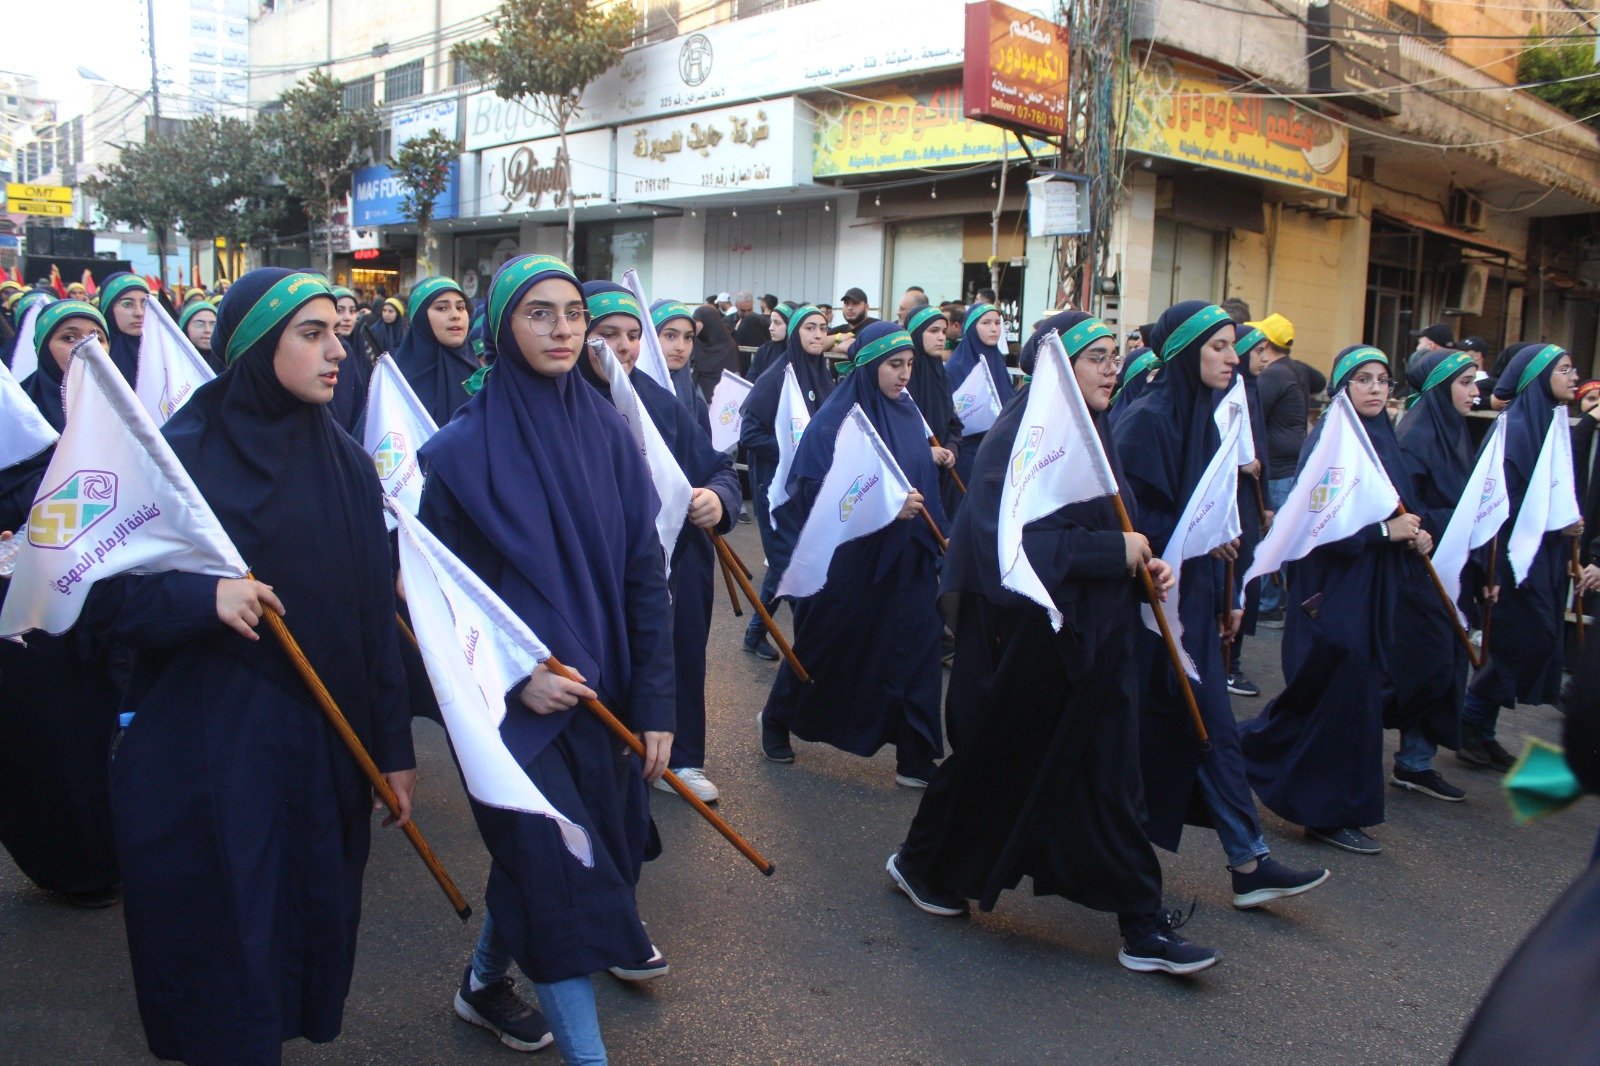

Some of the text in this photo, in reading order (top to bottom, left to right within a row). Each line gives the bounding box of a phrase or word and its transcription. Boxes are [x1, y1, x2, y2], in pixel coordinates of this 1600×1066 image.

[1010, 20, 1051, 45] مطعم
[996, 46, 1064, 84] الكومودور
[991, 71, 1064, 113] فول حمص مسبحة
[729, 109, 769, 148] شركة
[834, 83, 961, 150] الكومودور
[991, 96, 1016, 116] Delivery
[1049, 114, 1064, 130] 170
[1166, 87, 1314, 153] مطعم الكومودور
[633, 128, 683, 163] للصيرفة
[922, 145, 957, 162] مشوشة
[961, 142, 992, 158] مسبحة
[25, 186, 54, 198] OMT
[357, 179, 380, 202] MAF
[1038, 446, 1066, 469] كشافة
[862, 473, 879, 494] كشافة
[57, 502, 161, 596] كشافة الإمام المهدي
